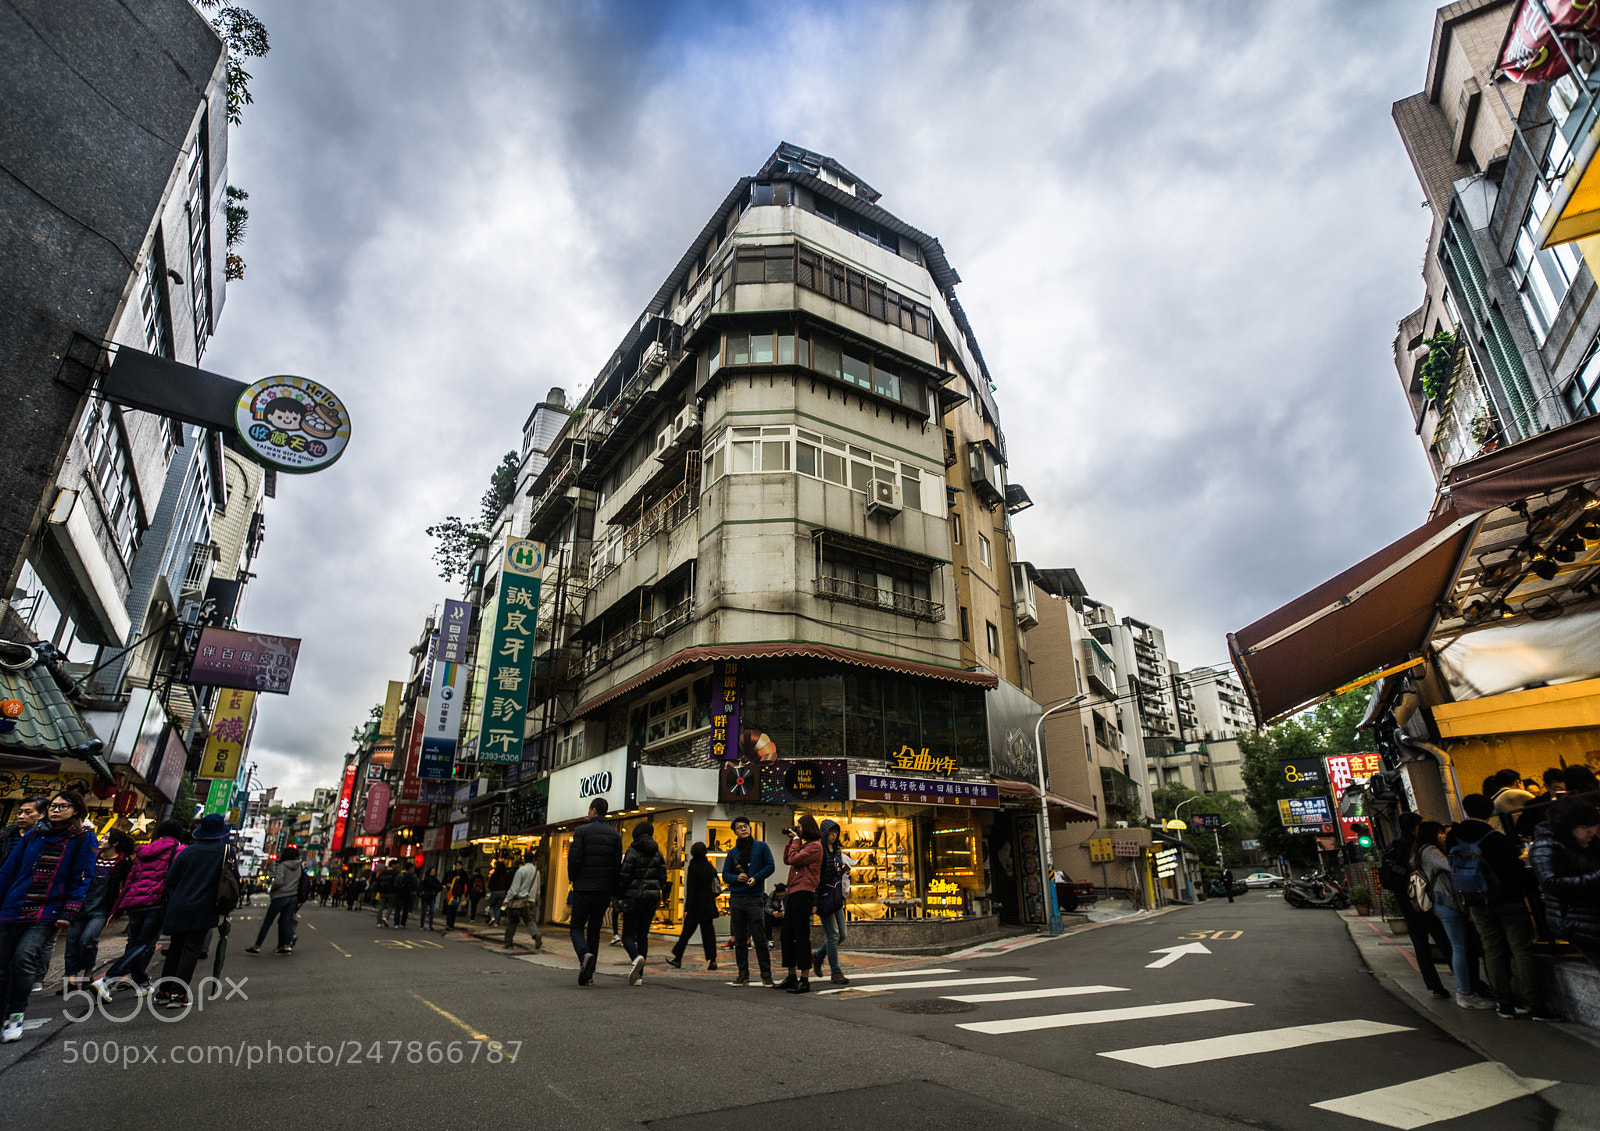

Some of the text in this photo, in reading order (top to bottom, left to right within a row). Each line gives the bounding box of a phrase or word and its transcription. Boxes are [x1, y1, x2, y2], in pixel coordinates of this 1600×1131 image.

[305, 383, 336, 408] Hello
[251, 426, 325, 456] 收藏天地
[256, 443, 315, 463] TAIWAN GIFT SHOP
[202, 645, 289, 667] 伴百度皮鞋
[485, 586, 536, 752] 誠良牙醫診所
[579, 770, 613, 799] KOKKO
[1330, 757, 1351, 789] 租
[338, 797, 349, 818] 高記
[1177, 929, 1244, 940] 30
